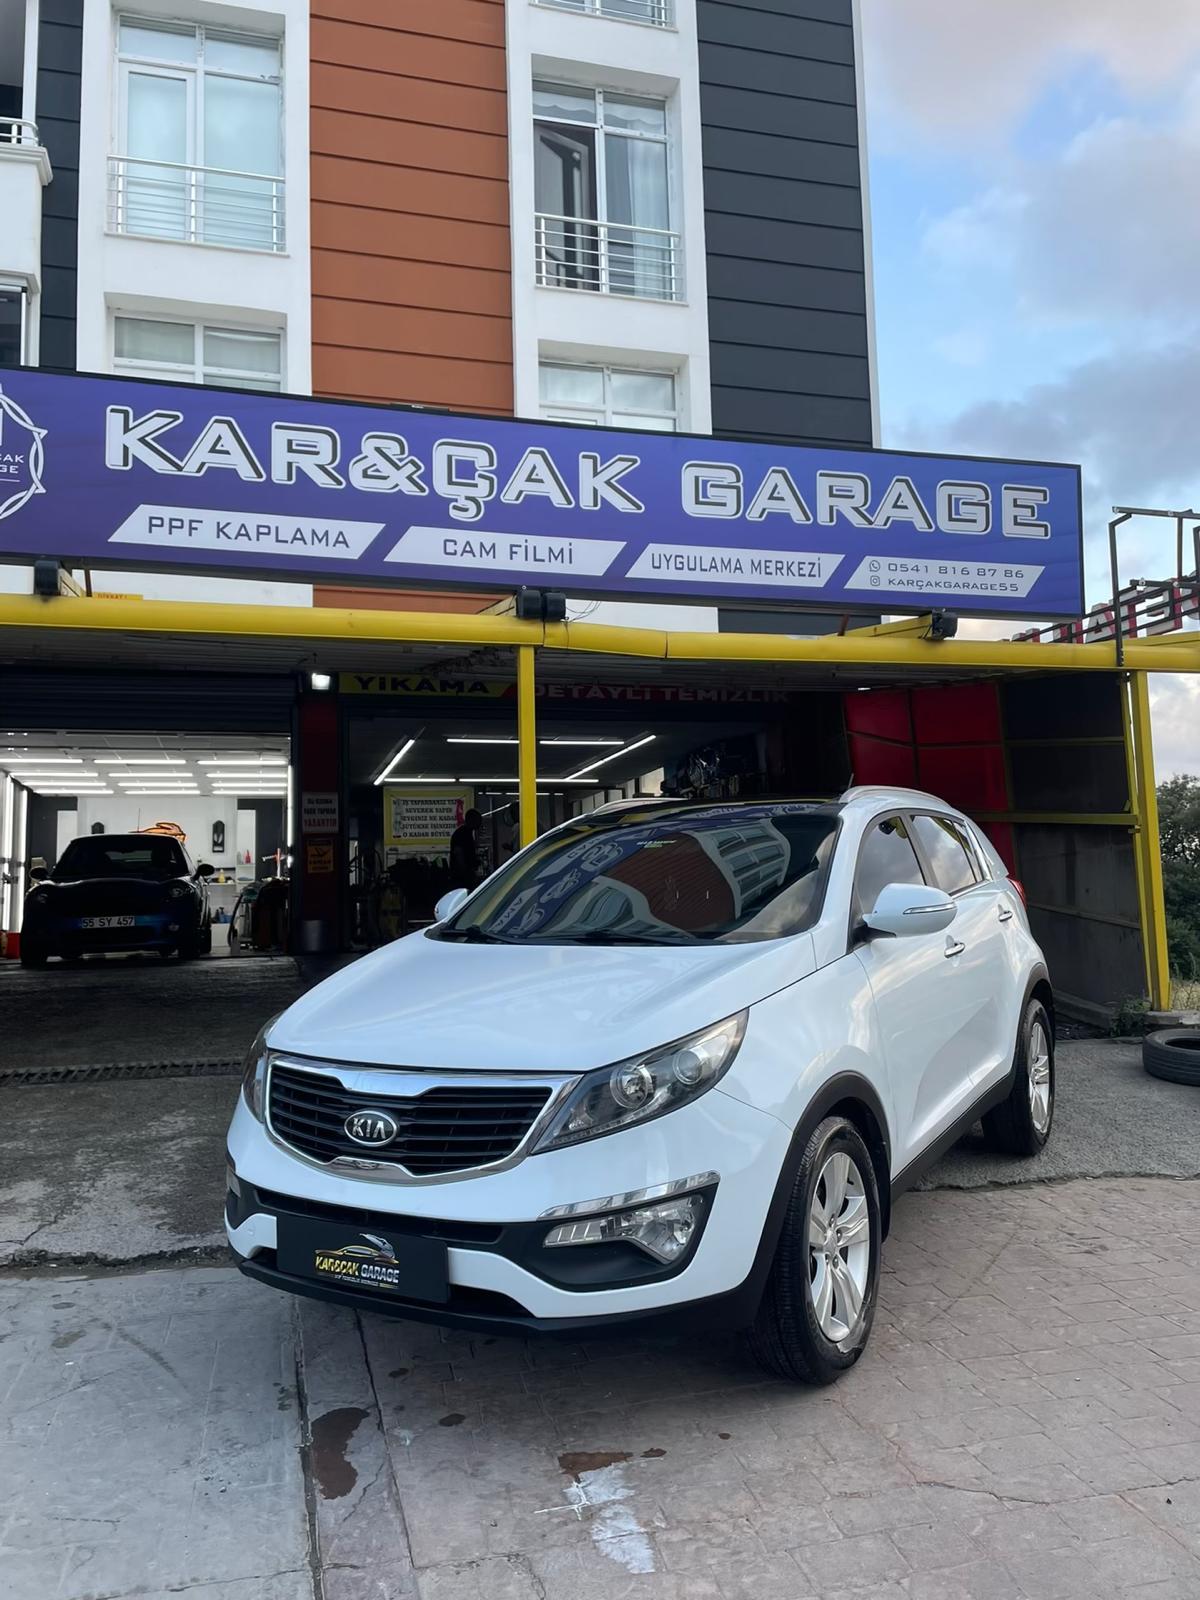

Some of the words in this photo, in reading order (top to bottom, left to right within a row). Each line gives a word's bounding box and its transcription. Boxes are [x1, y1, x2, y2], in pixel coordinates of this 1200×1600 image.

[105, 404, 646, 522] KAR&ÇAK
[681, 459, 1051, 540] GARAGE
[148, 516, 203, 537] PPF
[216, 521, 350, 549] KAPLAMA
[443, 538, 496, 560] CAM
[509, 539, 573, 565] FİLMİ
[651, 553, 744, 574] UYGULAMA
[750, 557, 821, 578] MERKEZİ
[888, 563, 929, 574] 0541
[938, 566, 970, 576] 816
[977, 568, 997, 577] 87
[1004, 569, 1024, 579] 86
[888, 577, 1019, 592] KARÇAKGARAGE55
[98, 918, 112, 927] SY
[117, 916, 134, 926] 457
[352, 1117, 386, 1139] KIA
[361, 1264, 400, 1284] GARAGE
